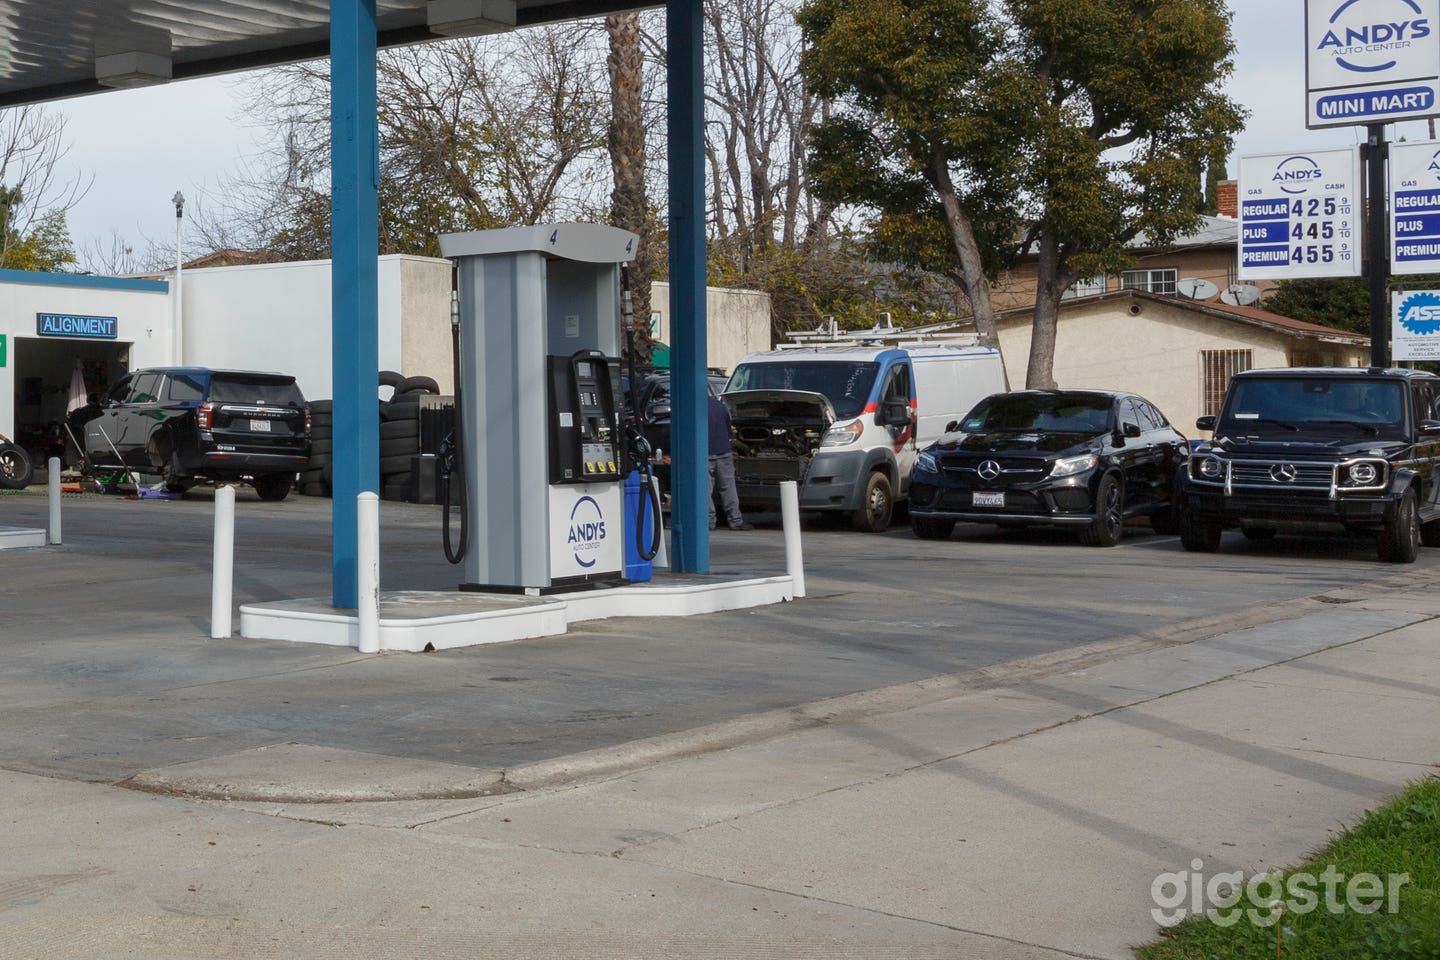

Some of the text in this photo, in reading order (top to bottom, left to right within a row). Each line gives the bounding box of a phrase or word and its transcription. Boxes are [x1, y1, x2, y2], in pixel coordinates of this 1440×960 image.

[1317, 19, 1430, 50] ANDYS
[1331, 41, 1411, 56] AUTO CENTER
[1322, 92, 1430, 116] MINI MART
[1272, 169, 1322, 181] ANDYS
[1396, 195, 1440, 208] REGULA
[1243, 204, 1288, 217] REGULAR
[1243, 228, 1268, 239] PLUS
[1397, 221, 1423, 232] PLUS
[549, 229, 558, 245] 4
[625, 238, 634, 254] 4
[1397, 244, 1440, 256] PREMIU
[1243, 251, 1288, 263] PREMIUM
[43, 316, 113, 334] ALIGNMENT
[568, 521, 606, 544] ANDYS
